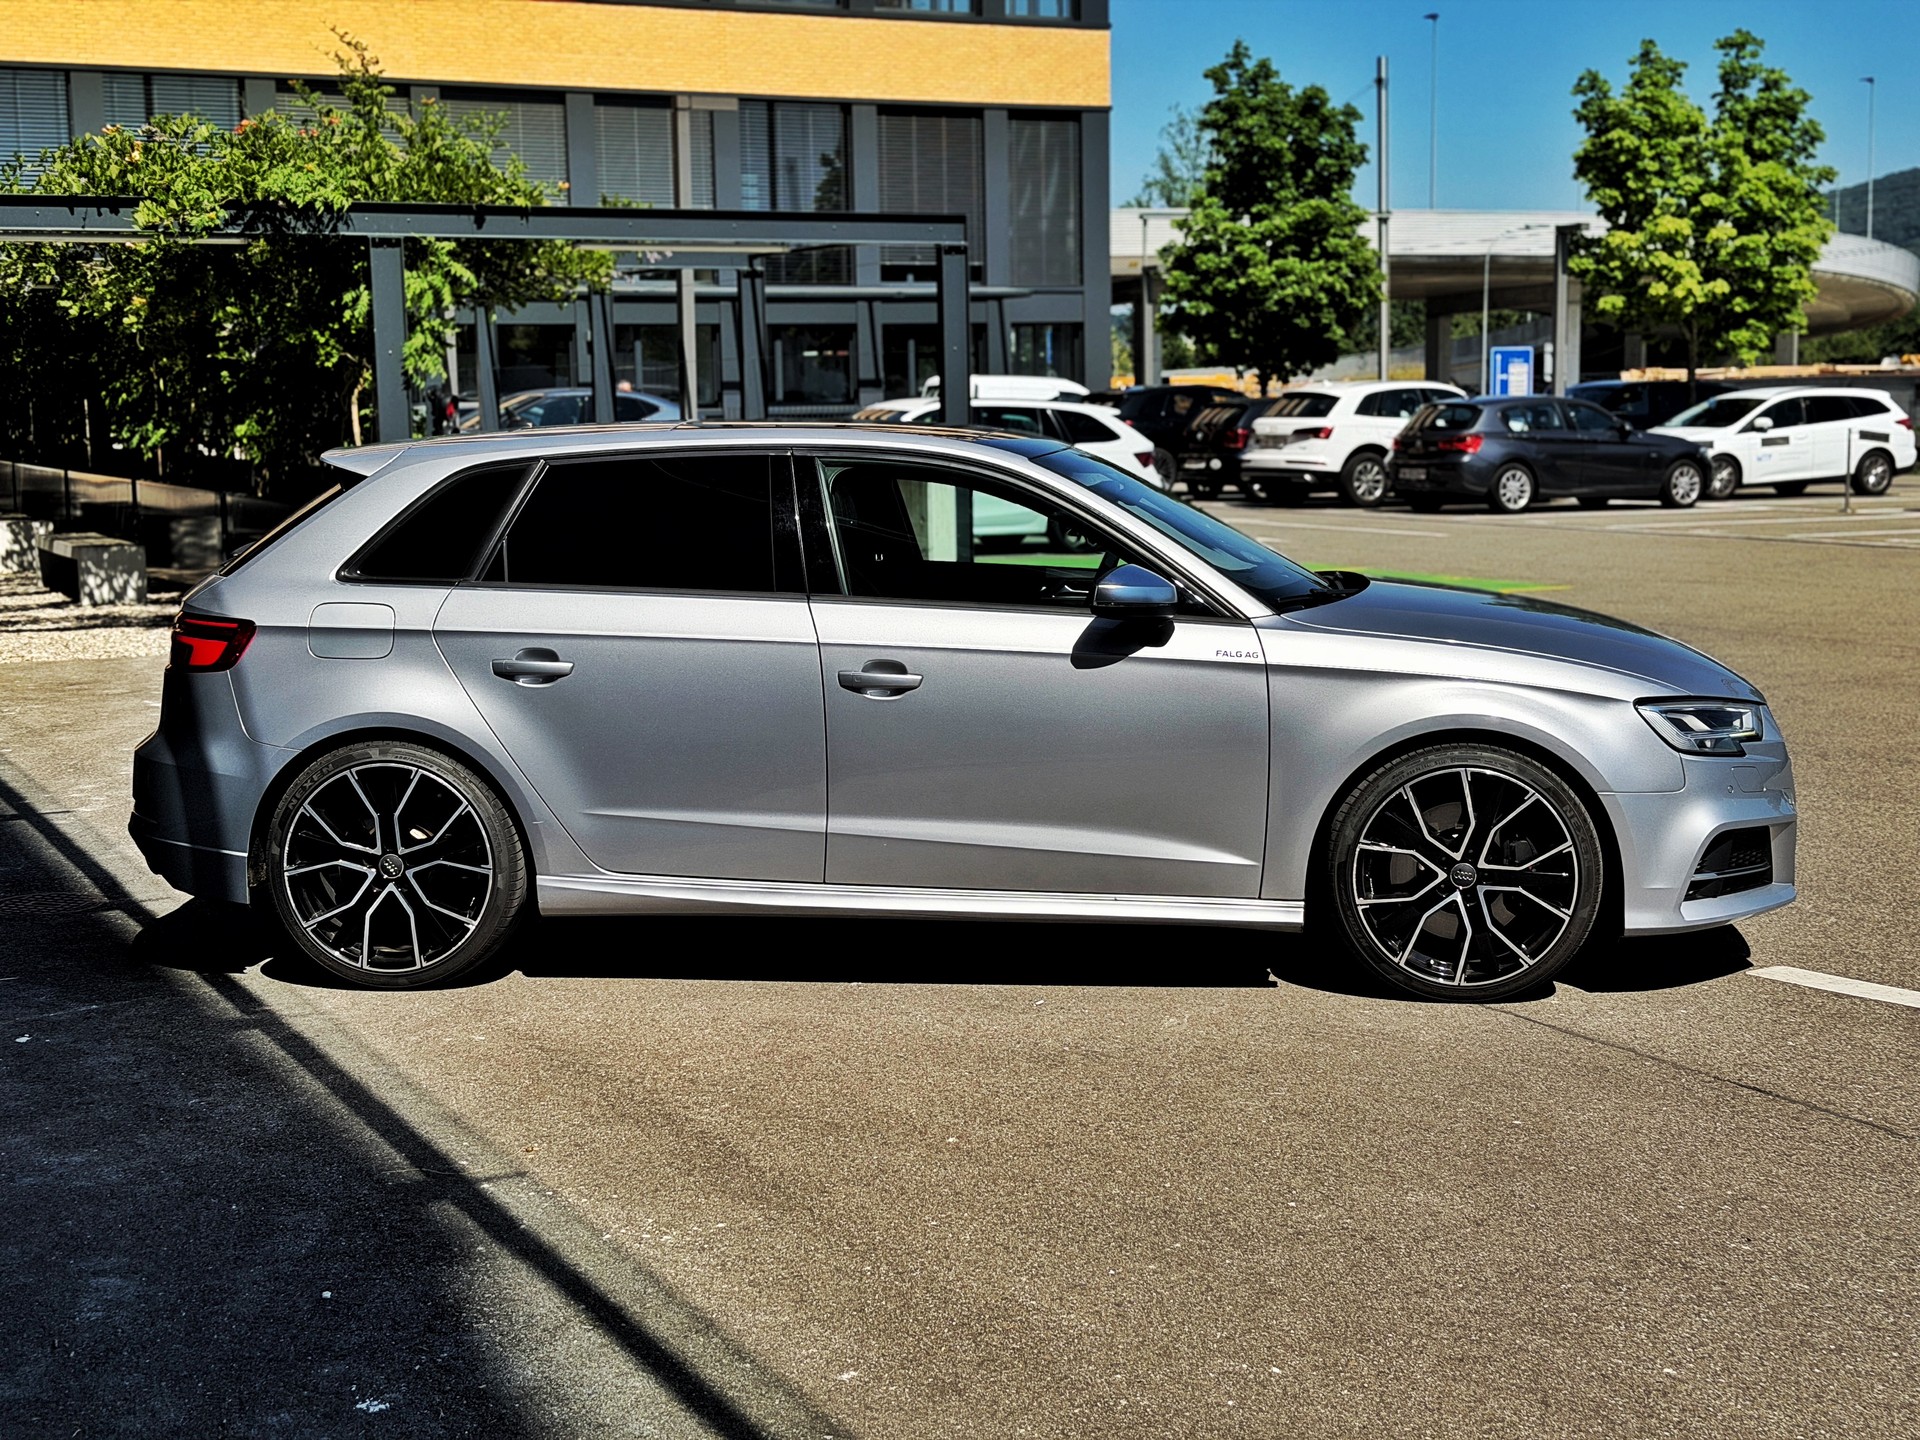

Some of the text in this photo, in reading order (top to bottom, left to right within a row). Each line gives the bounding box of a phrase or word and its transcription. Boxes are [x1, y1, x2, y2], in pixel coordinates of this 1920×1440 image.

[1215, 649, 1259, 659] FALG AG
[287, 763, 335, 810] NEXEN
[1562, 804, 1592, 867] NEXEN
